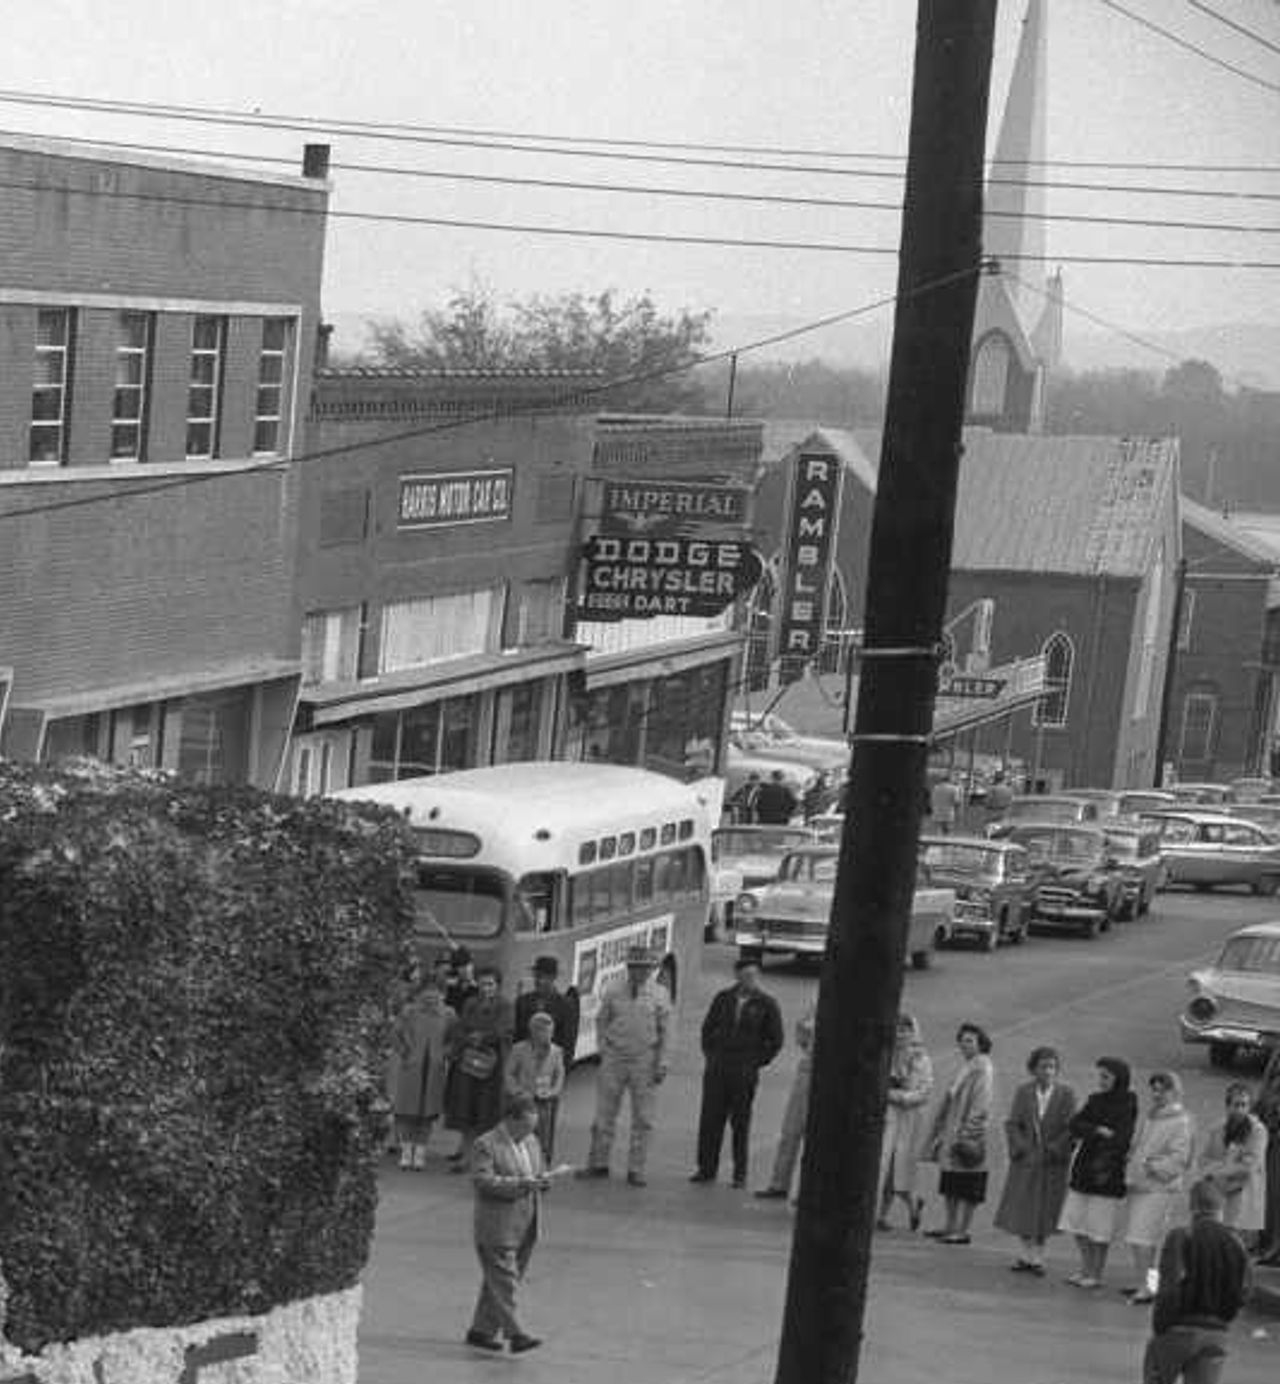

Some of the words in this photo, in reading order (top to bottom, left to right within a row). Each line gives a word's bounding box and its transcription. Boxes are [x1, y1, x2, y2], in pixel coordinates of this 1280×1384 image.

[608, 489, 737, 516] IMPERIAL
[593, 538, 741, 567] DODGE
[788, 460, 830, 650] RAMBLER
[593, 565, 735, 595] CHRYSLER
[634, 594, 692, 613] DART
